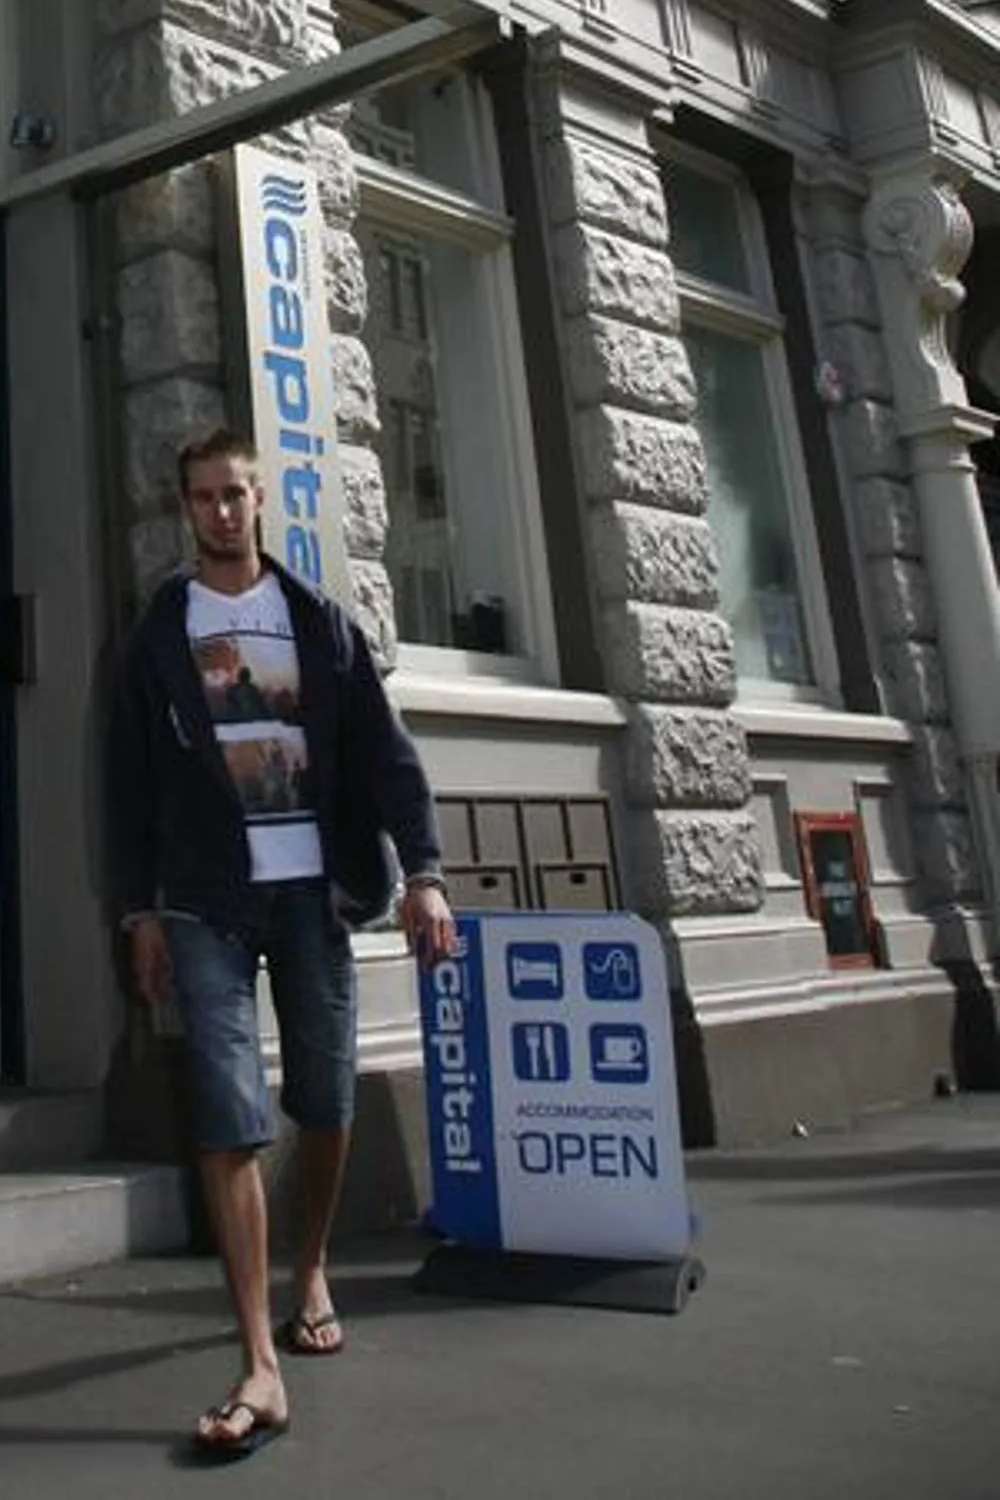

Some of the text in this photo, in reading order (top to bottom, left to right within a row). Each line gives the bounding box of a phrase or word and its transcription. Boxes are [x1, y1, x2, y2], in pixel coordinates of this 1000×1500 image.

[263, 217, 325, 587] capita
[430, 960, 482, 1173] capital
[516, 1103, 654, 1122] ACCOMMODATION
[518, 1131, 658, 1180] OPEN
